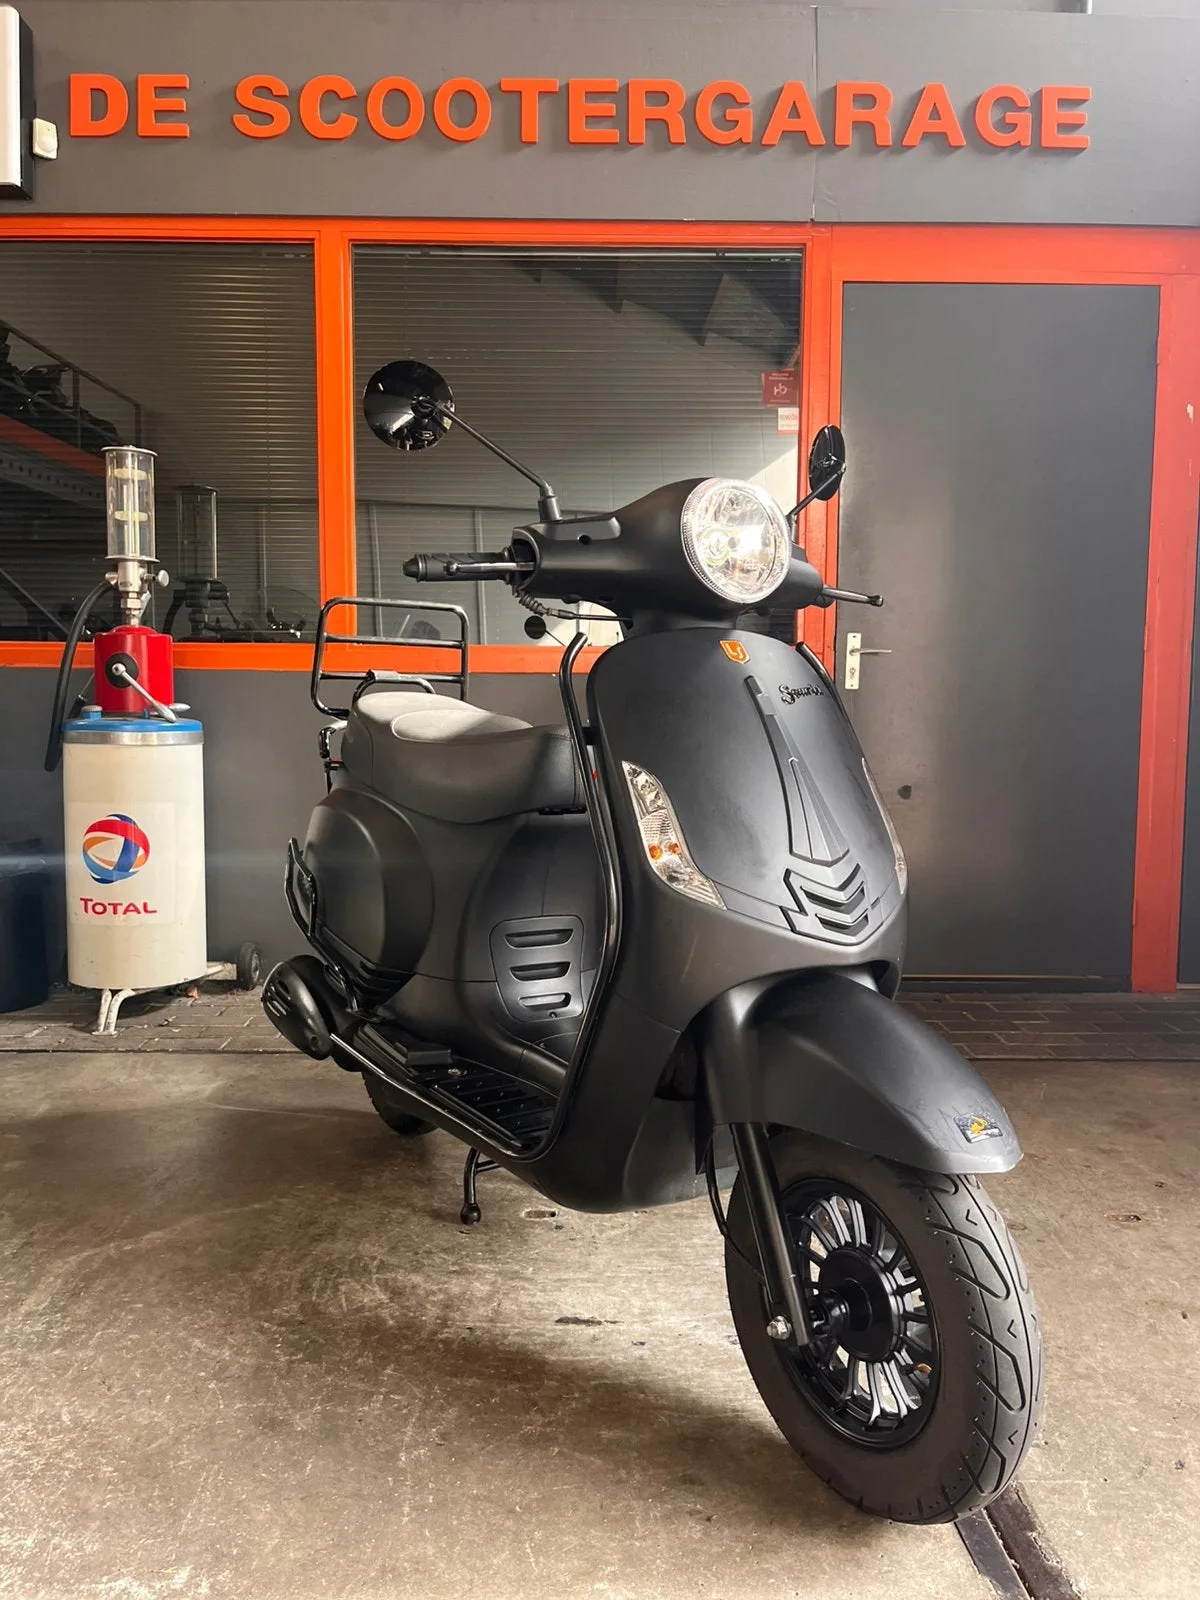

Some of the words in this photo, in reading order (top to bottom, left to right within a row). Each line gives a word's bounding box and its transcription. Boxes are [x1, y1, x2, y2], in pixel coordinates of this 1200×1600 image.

[69, 73, 190, 138] DE
[232, 75, 1092, 149] SCOOTERGARAGE
[80, 897, 158, 916] TOTAL
